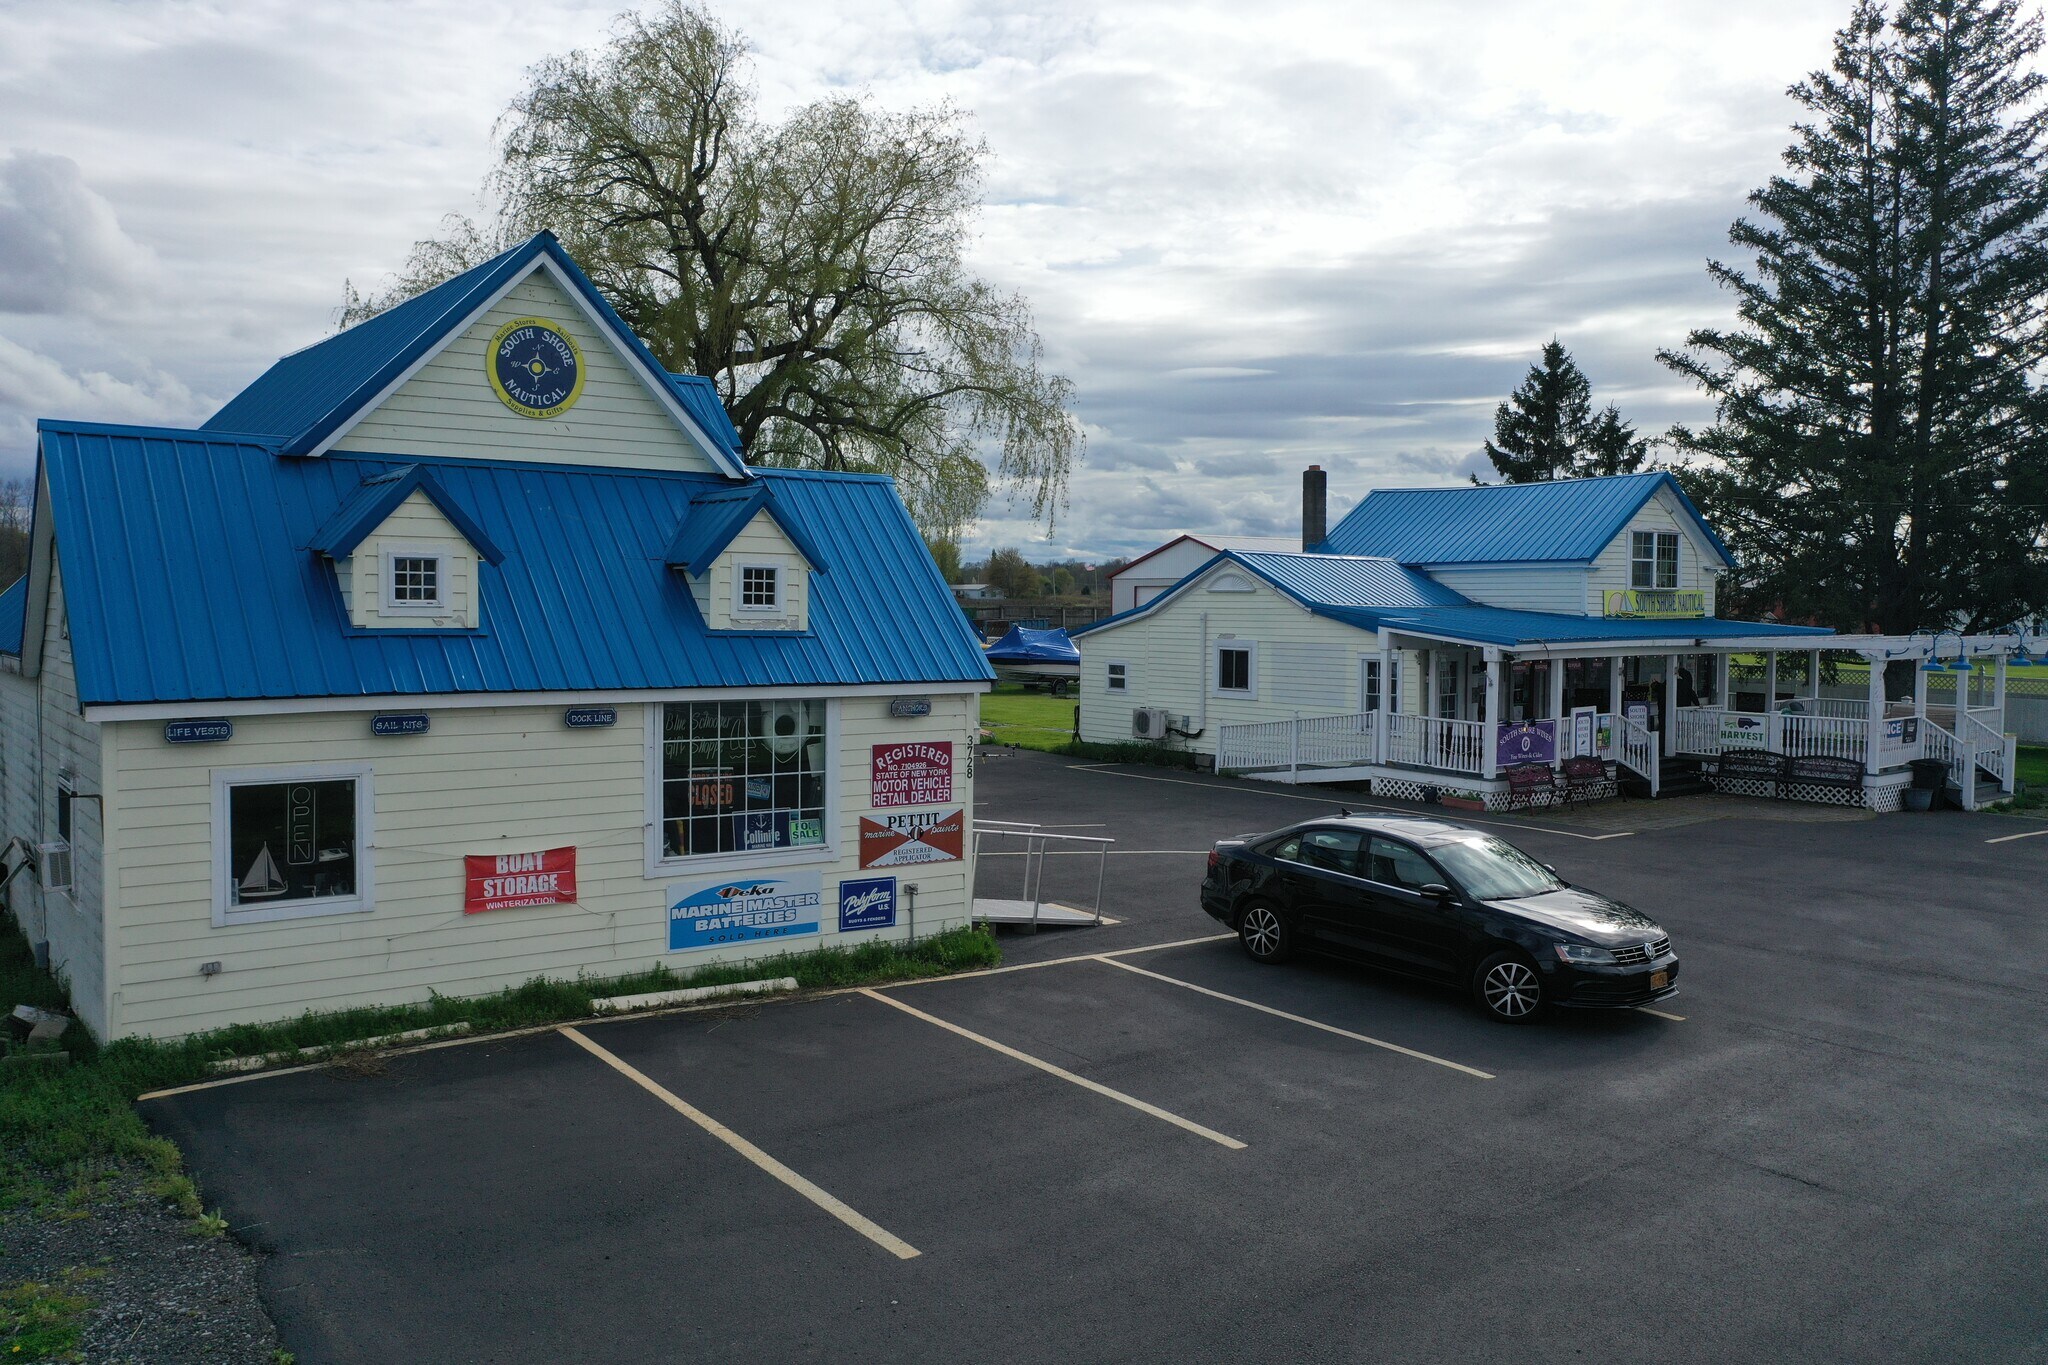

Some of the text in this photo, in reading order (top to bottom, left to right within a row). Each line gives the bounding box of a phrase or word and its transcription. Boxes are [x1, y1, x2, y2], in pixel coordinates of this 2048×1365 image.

[495, 319, 536, 343] Marine Stores
[500, 328, 574, 367] SOUTH SHORE
[555, 327, 579, 355] Sailboats
[505, 378, 566, 405] NAUTICAL
[506, 398, 536, 416] Supplies
[546, 406, 563, 416] Gifts
[1635, 593, 1704, 612] SOUTH SHORE NAUTICAL
[375, 720, 423, 730] SAIL KITS
[571, 714, 612, 723] DOCK LINE
[665, 713, 687, 731] Blue
[168, 726, 228, 737] LIFE VESTS
[1499, 729, 1518, 746] SOUTH
[1536, 727, 1553, 742] WINES
[1720, 730, 1764, 742] HARVEST
[665, 735, 725, 760] Gift Shoppe
[875, 744, 949, 770] REGISTERED
[966, 735, 974, 779] 3728
[875, 771, 898, 780] STATE
[911, 769, 928, 778] NEW
[929, 768, 948, 776] YORK
[887, 764, 900, 772] NO.
[873, 776, 951, 793] MOTOR VEHICLE
[687, 783, 733, 806] CLOSED
[873, 789, 951, 806] RETAIL DEALER
[291, 786, 311, 861] OPEN
[887, 812, 940, 829] PETTIT
[792, 829, 820, 840] SALE
[864, 822, 960, 839] marine paints
[893, 847, 933, 856] REGISTERED
[893, 854, 932, 862] APPLICATOR
[495, 852, 546, 875] BOAT
[483, 873, 558, 898] STORAGE
[721, 885, 775, 899] Deka
[485, 896, 556, 910] WINTERIZATION
[671, 892, 819, 920] MARINE MASTER
[843, 887, 892, 915] Polyform
[694, 908, 797, 932] BATTERIES
[708, 927, 789, 943] SOLD HERE
